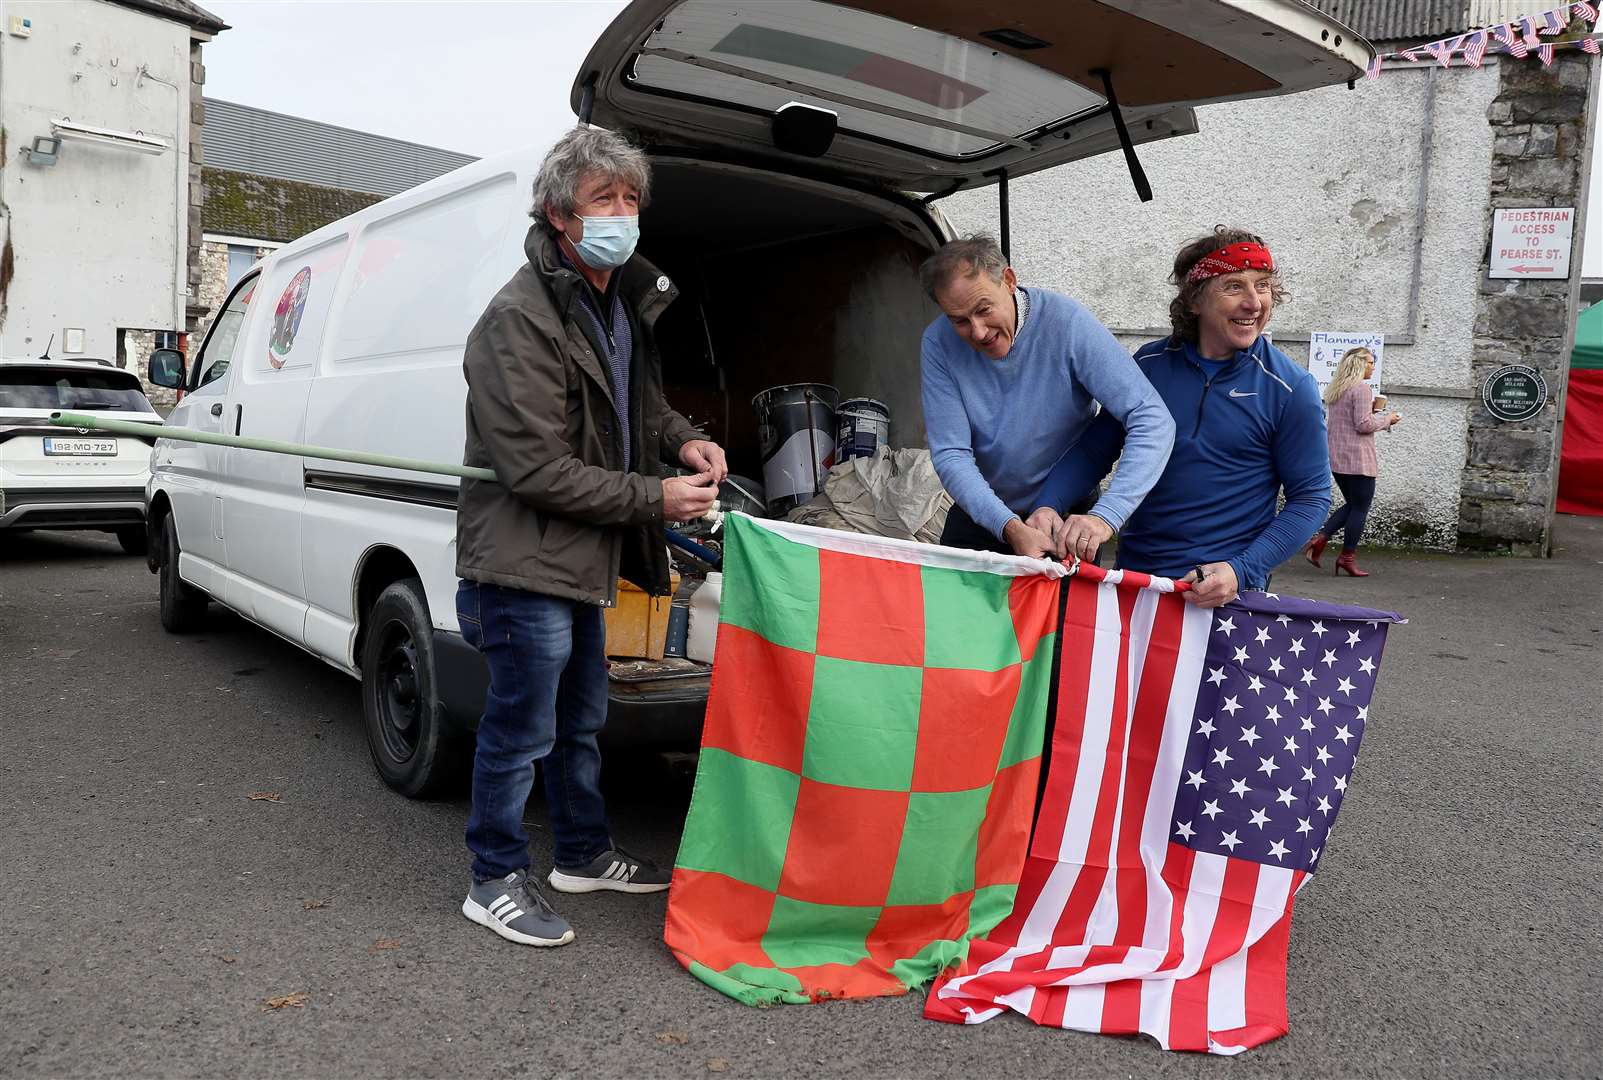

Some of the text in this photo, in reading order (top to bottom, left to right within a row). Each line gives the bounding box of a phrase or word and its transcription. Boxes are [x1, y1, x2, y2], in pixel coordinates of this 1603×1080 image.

[1501, 211, 1569, 222] PEDESTRIAN
[1511, 224, 1555, 234] ACCESS
[1526, 237, 1540, 247] TO
[1500, 249, 1562, 260] PEARSE ST.
[1314, 333, 1382, 347] Flannery's
